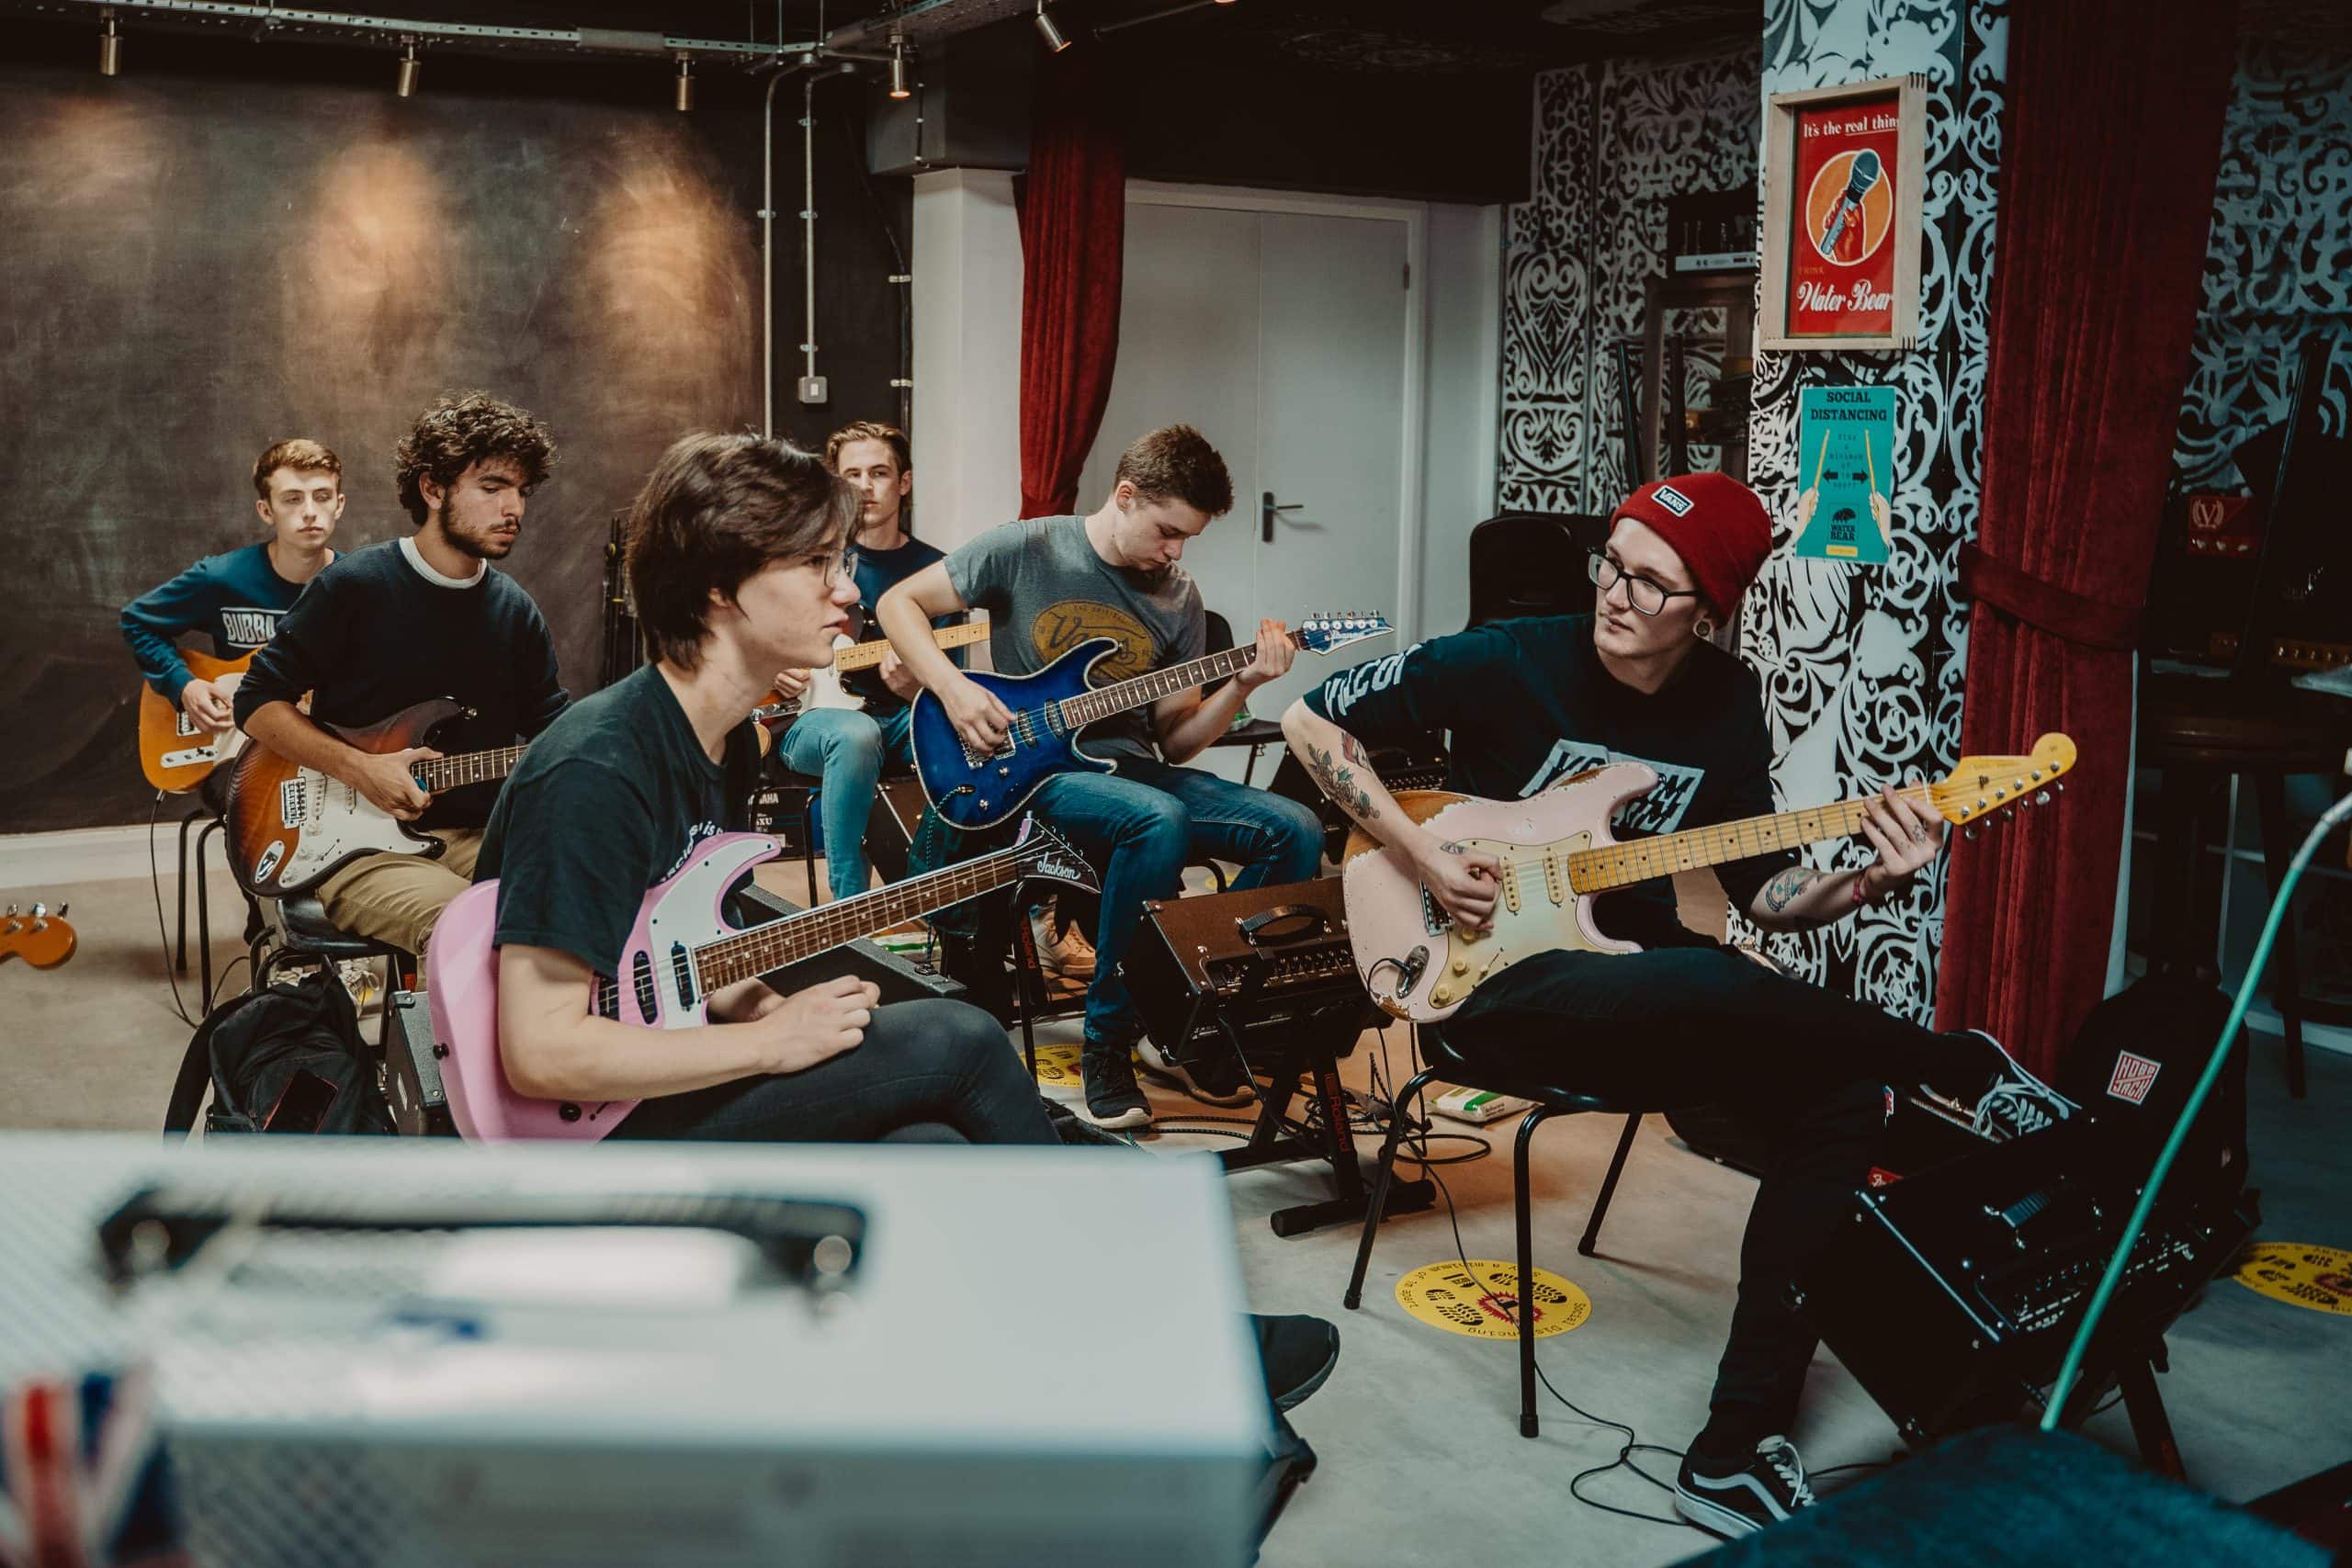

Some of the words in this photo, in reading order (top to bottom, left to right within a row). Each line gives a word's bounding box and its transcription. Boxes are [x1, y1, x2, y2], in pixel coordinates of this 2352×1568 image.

[1803, 122, 1820, 138] It's
[1824, 120, 1841, 135] the
[1845, 116, 1868, 133] real
[1796, 280, 1847, 311] Water
[1847, 278, 1894, 311] Bear
[1826, 391, 1871, 403] SOCIAL
[1811, 409, 1887, 422] DISTANCING
[1659, 489, 1689, 512] VANS
[1830, 531, 1855, 542] BEAR
[1037, 852, 1081, 880] Jackson
[2112, 1078, 2151, 1100] JACK
[1467, 1325, 1563, 1337] Disncing
